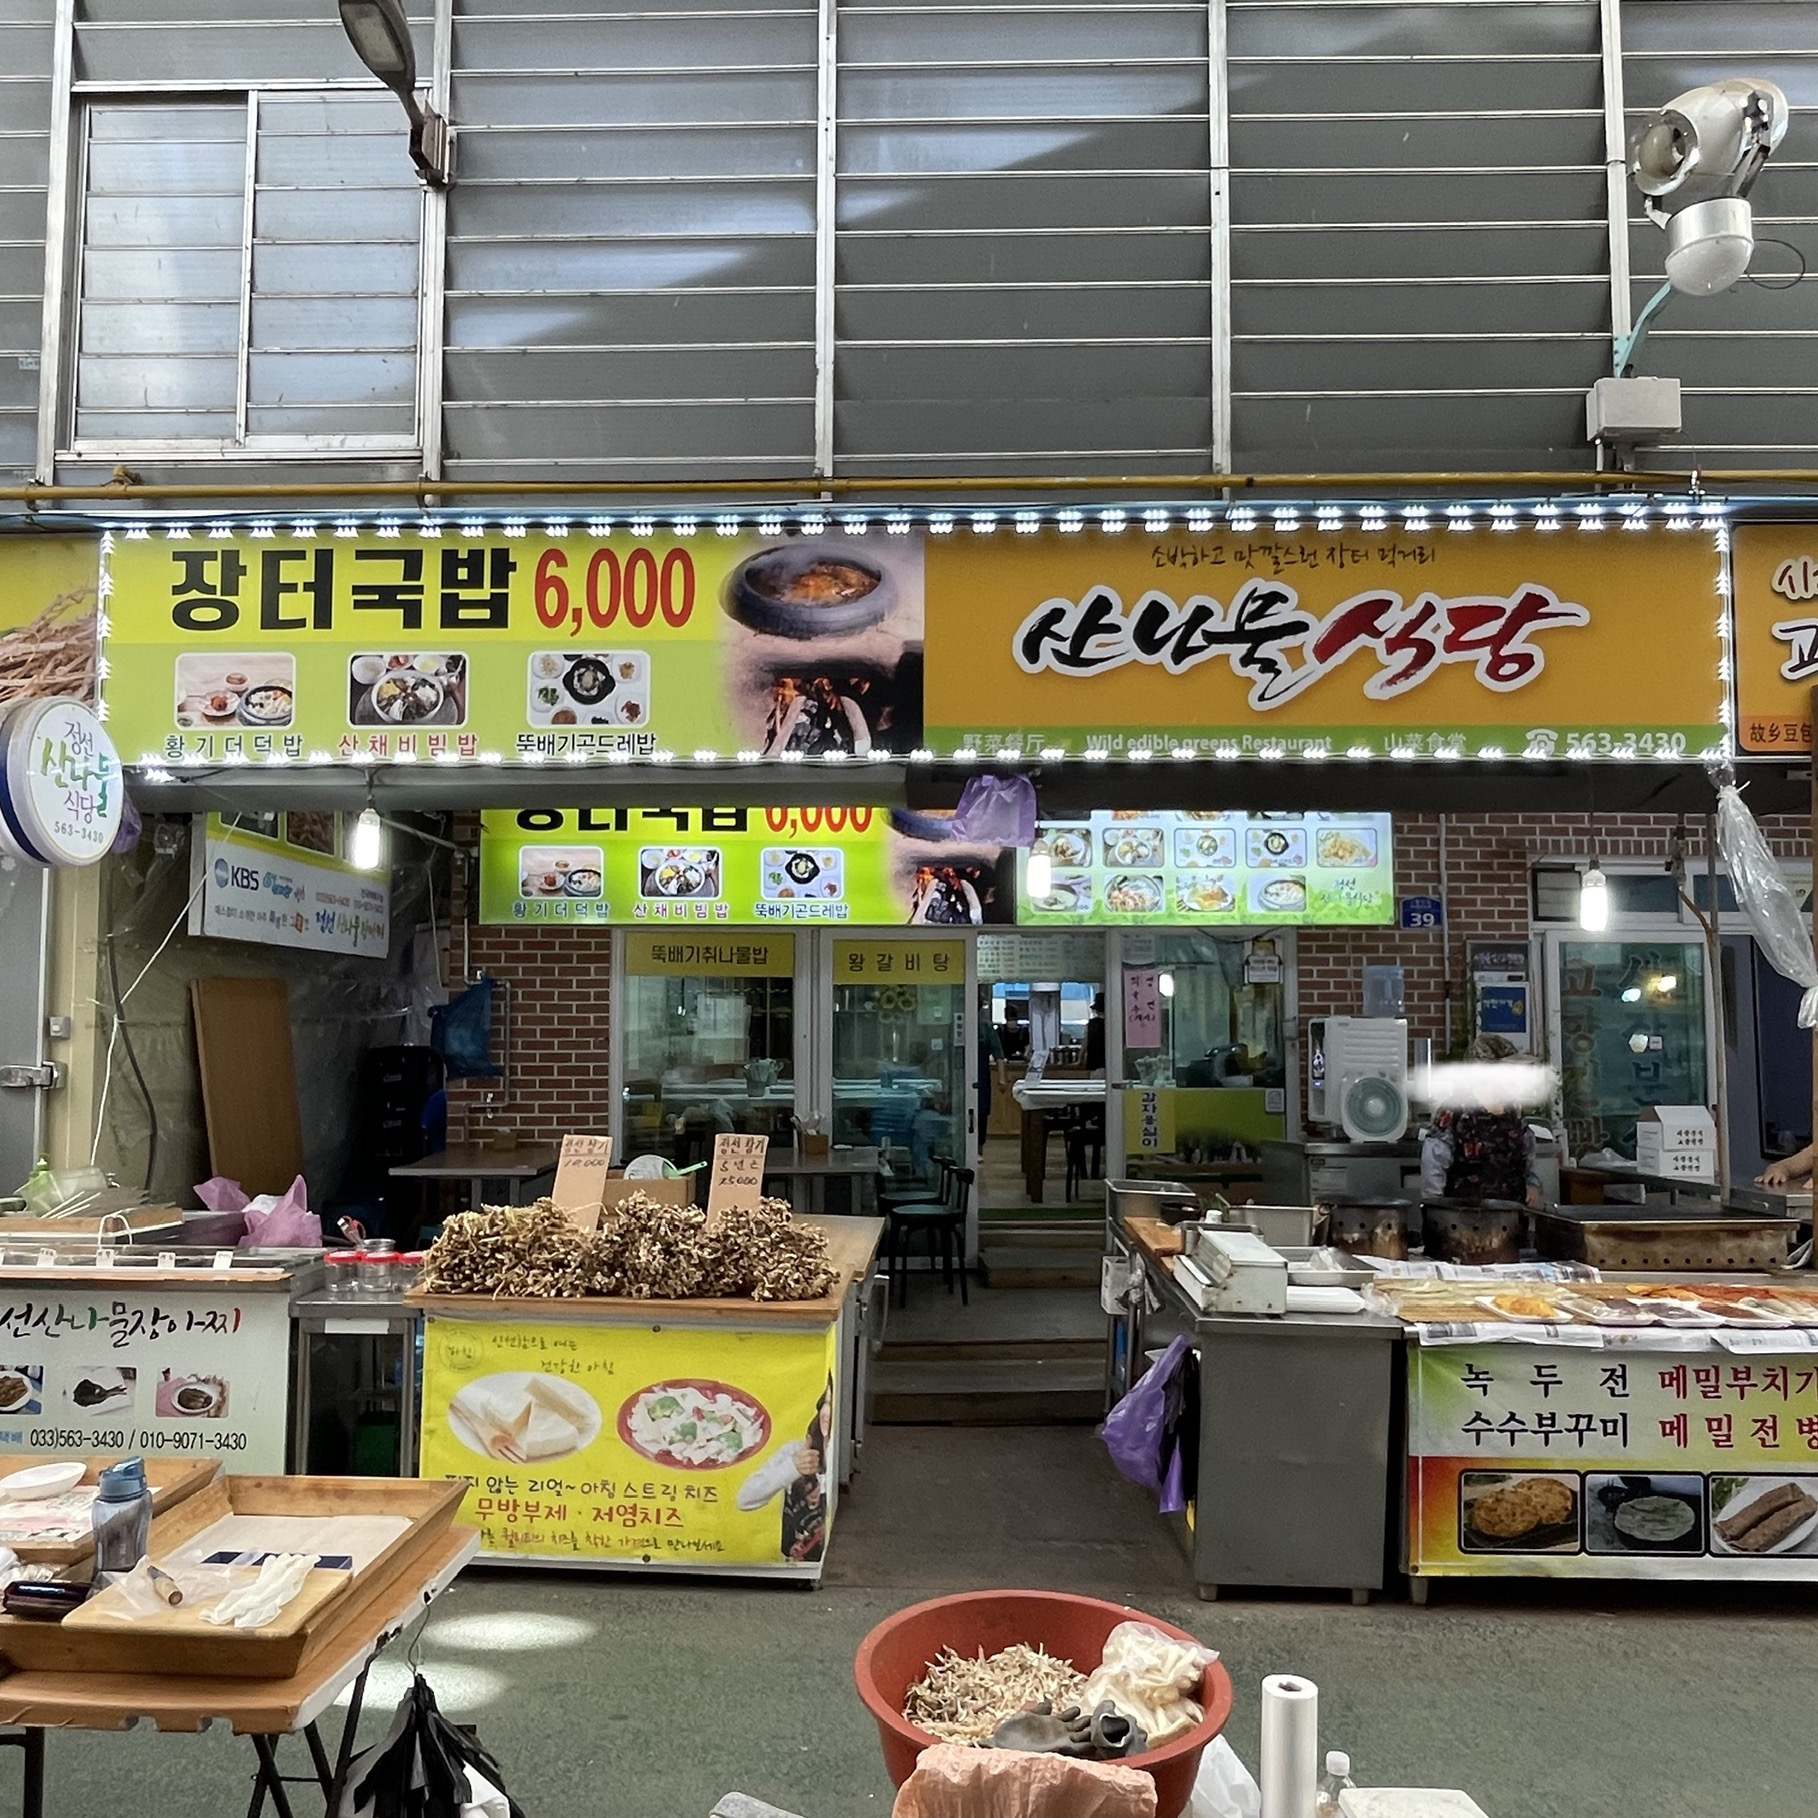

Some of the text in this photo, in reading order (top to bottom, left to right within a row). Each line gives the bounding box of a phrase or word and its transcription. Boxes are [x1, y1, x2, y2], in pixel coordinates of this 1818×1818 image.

[1151, 544, 1226, 568] 소박하고
[1326, 542, 1370, 569] 장터
[1377, 545, 1437, 568] 먹거리
[171, 547, 696, 637] 장터국밥 6,000
[1021, 586, 1581, 703] 산나물식당
[64, 721, 94, 758] 정선
[1086, 734, 1333, 756] Wild edible greens Restaurant
[1566, 732, 1687, 753] 563-3430
[63, 791, 94, 825] 식당
[54, 820, 104, 845] 563-3430
[231, 865, 260, 892] KBS
[1409, 912, 1435, 928] 39
[650, 944, 770, 967] 뚝배기취나물밥
[847, 951, 951, 973] 왕갈비탕
[586, 1360, 615, 1375] 아침
[30, 1428, 125, 1449] 033)563-3430
[139, 1430, 247, 1450] 010-9071-3430
[1460, 1410, 1630, 1448] 수수부꾸미
[486, 1475, 519, 1495] 않는
[474, 1497, 685, 1529] 무방부제 저염치즈
